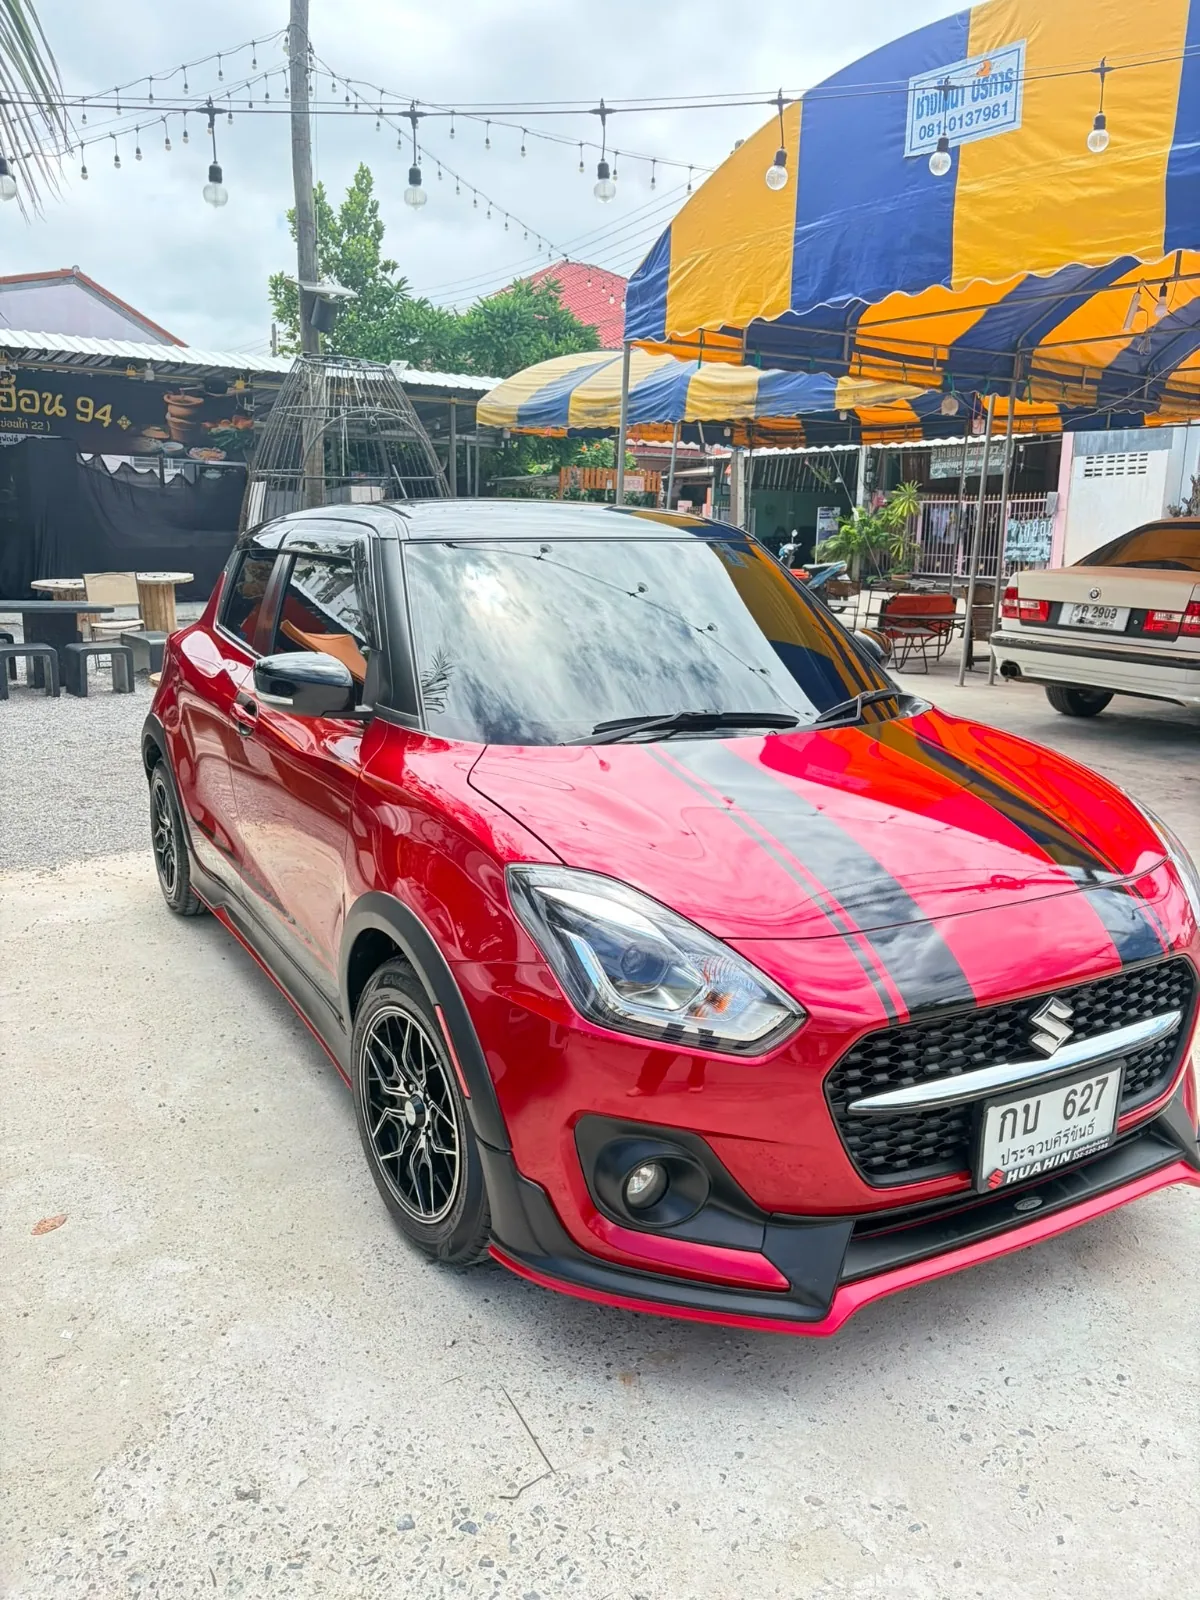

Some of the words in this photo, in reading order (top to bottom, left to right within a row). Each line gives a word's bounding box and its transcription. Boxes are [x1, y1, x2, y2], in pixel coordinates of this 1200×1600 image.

[75, 396, 112, 428] 94
[998, 1100, 1041, 1143] กบ
[1062, 1076, 1109, 1121] 627
[1001, 1117, 1096, 1166] ประจวบคีรีขันธ์
